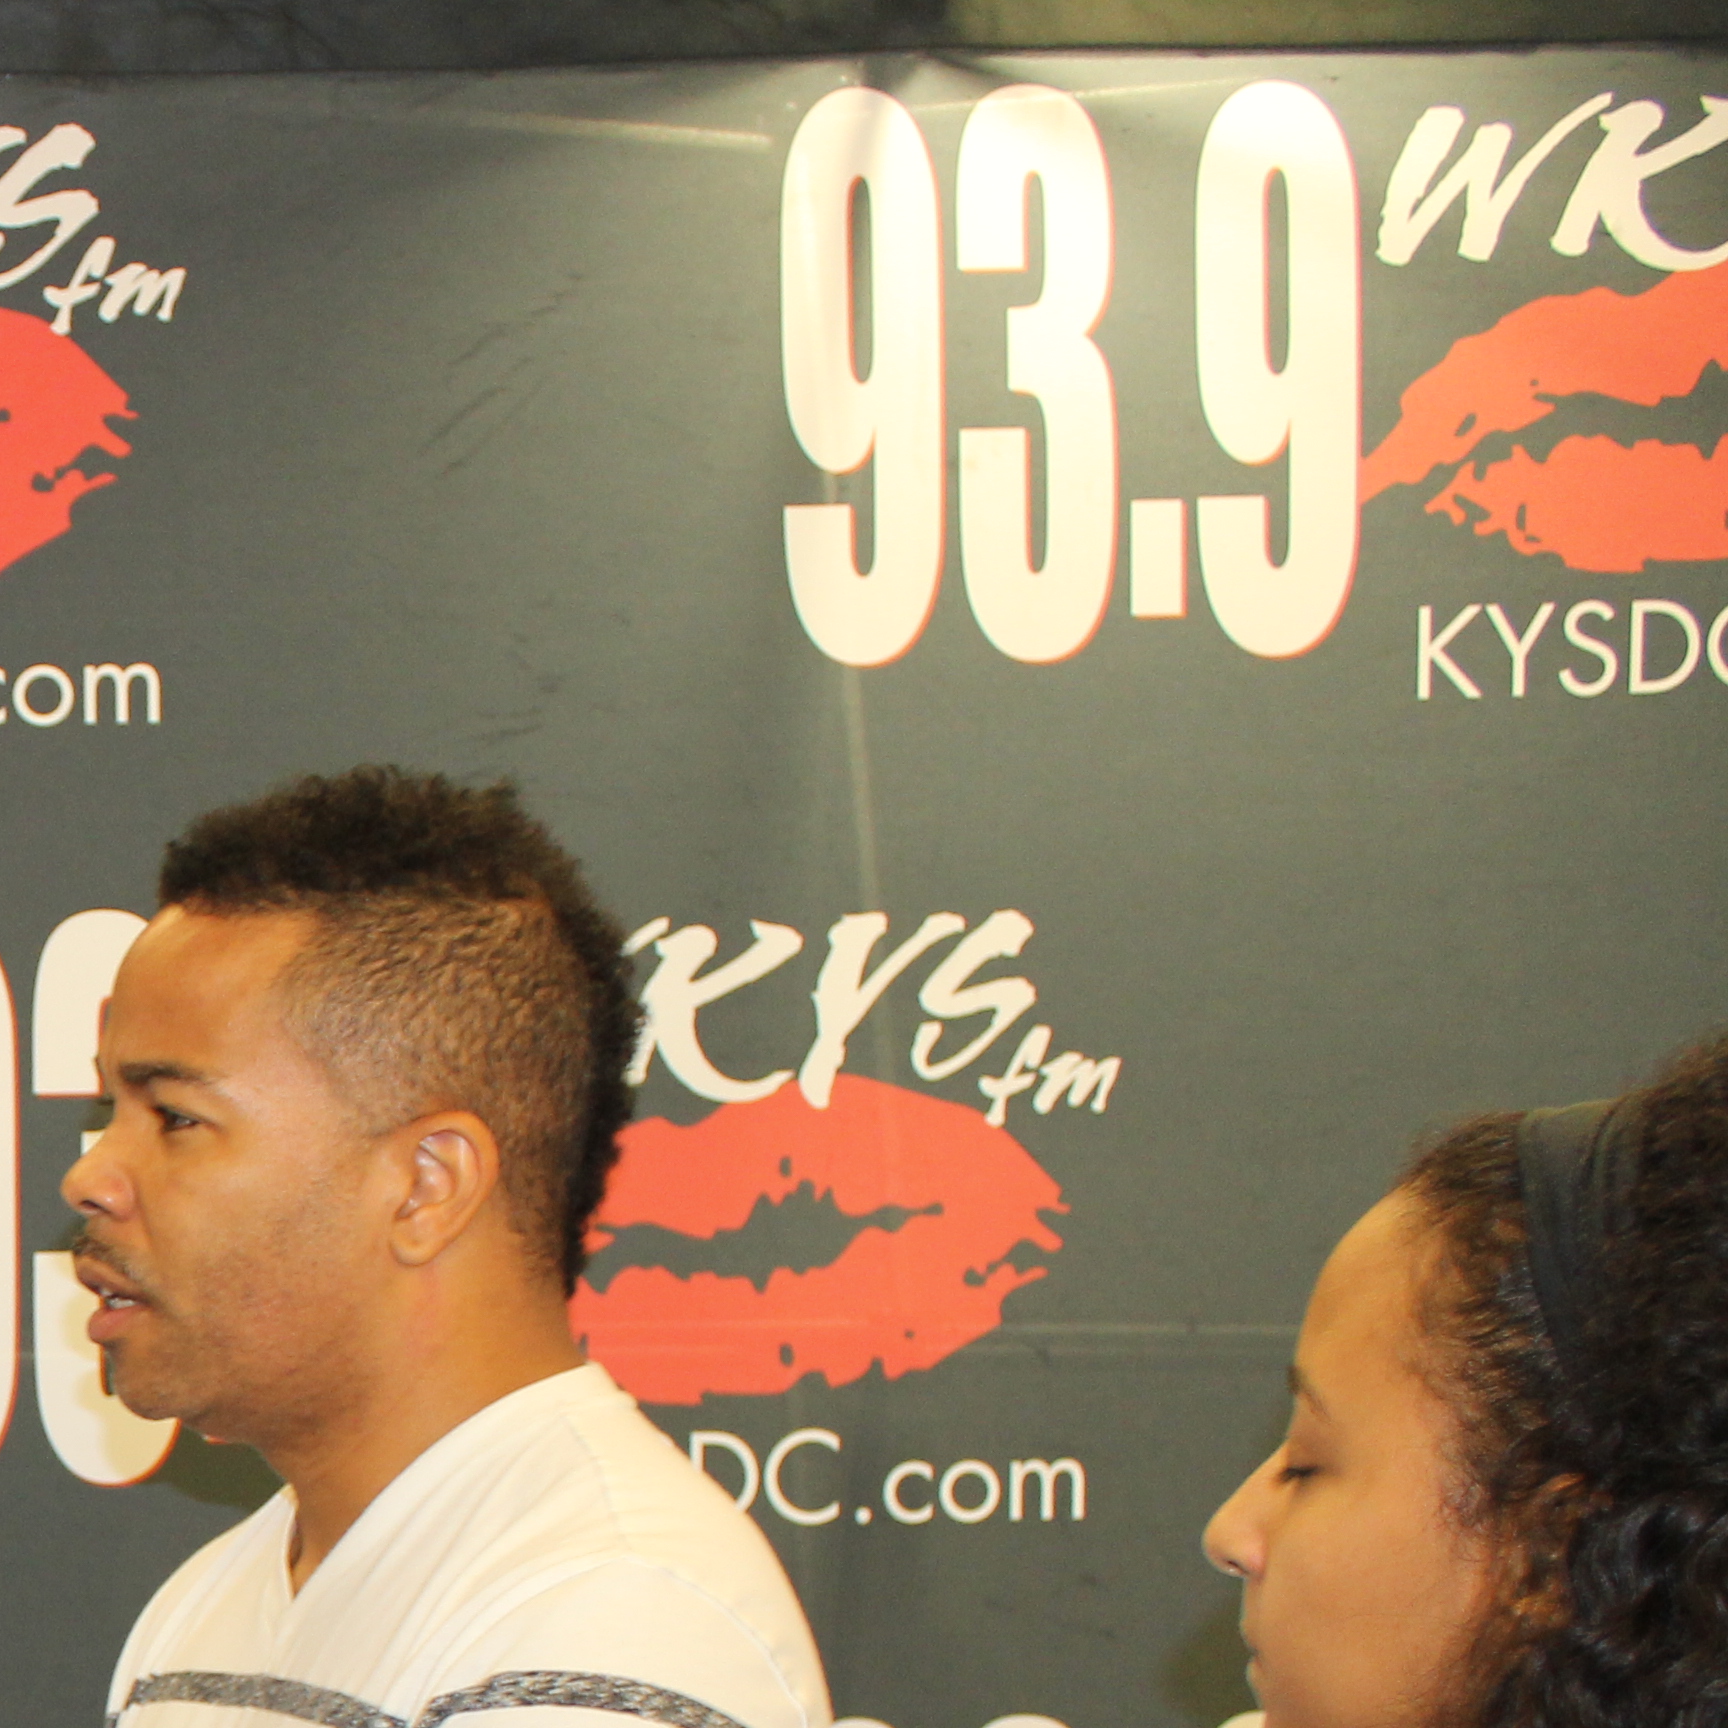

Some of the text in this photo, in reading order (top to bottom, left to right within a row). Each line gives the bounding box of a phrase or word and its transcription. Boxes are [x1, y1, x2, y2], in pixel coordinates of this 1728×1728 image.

[43, 235, 187, 334] fm
[780, 79, 1361, 668] 93.9
[621, 908, 1123, 1128] KYS fm
